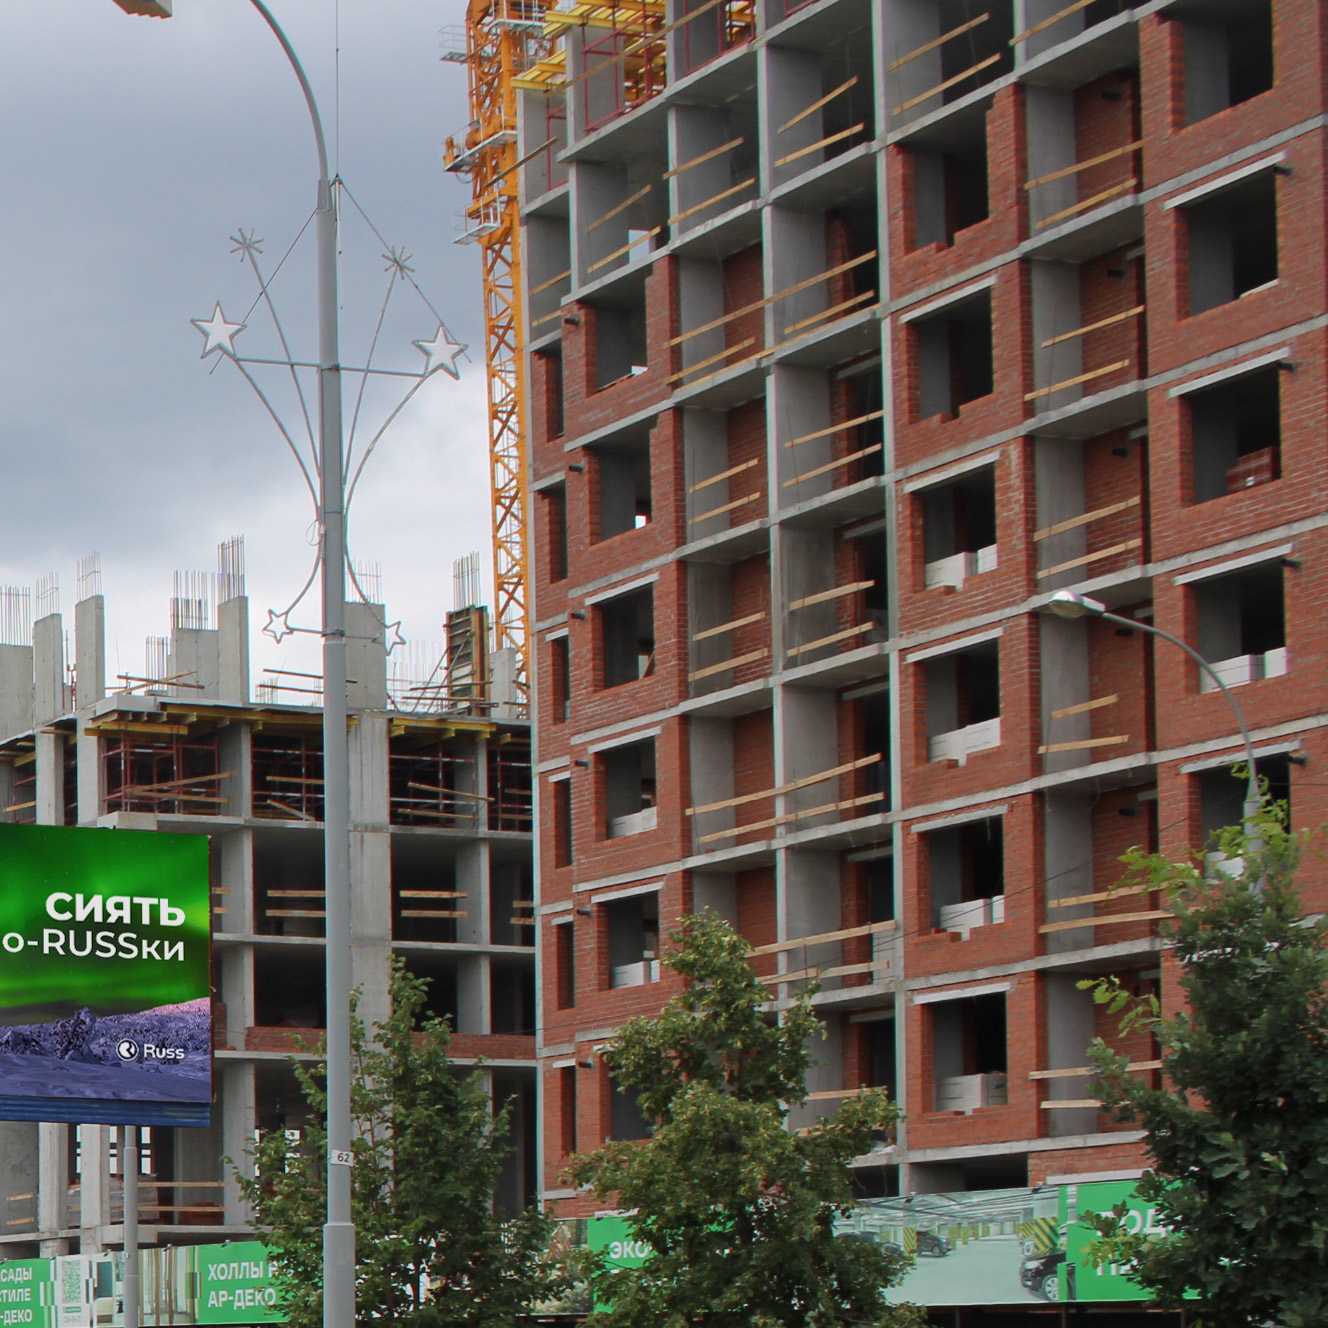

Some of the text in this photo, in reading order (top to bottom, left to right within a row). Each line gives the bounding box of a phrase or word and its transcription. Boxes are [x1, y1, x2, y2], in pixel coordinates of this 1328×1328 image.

[45, 892, 186, 927] СИЯТЬ
[143, 1044, 185, 1059] Russ
[337, 1152, 350, 1162] 62
[207, 1261, 264, 1280] ХОЛЛЫ
[207, 1287, 277, 1310] АР-ДЕКО
